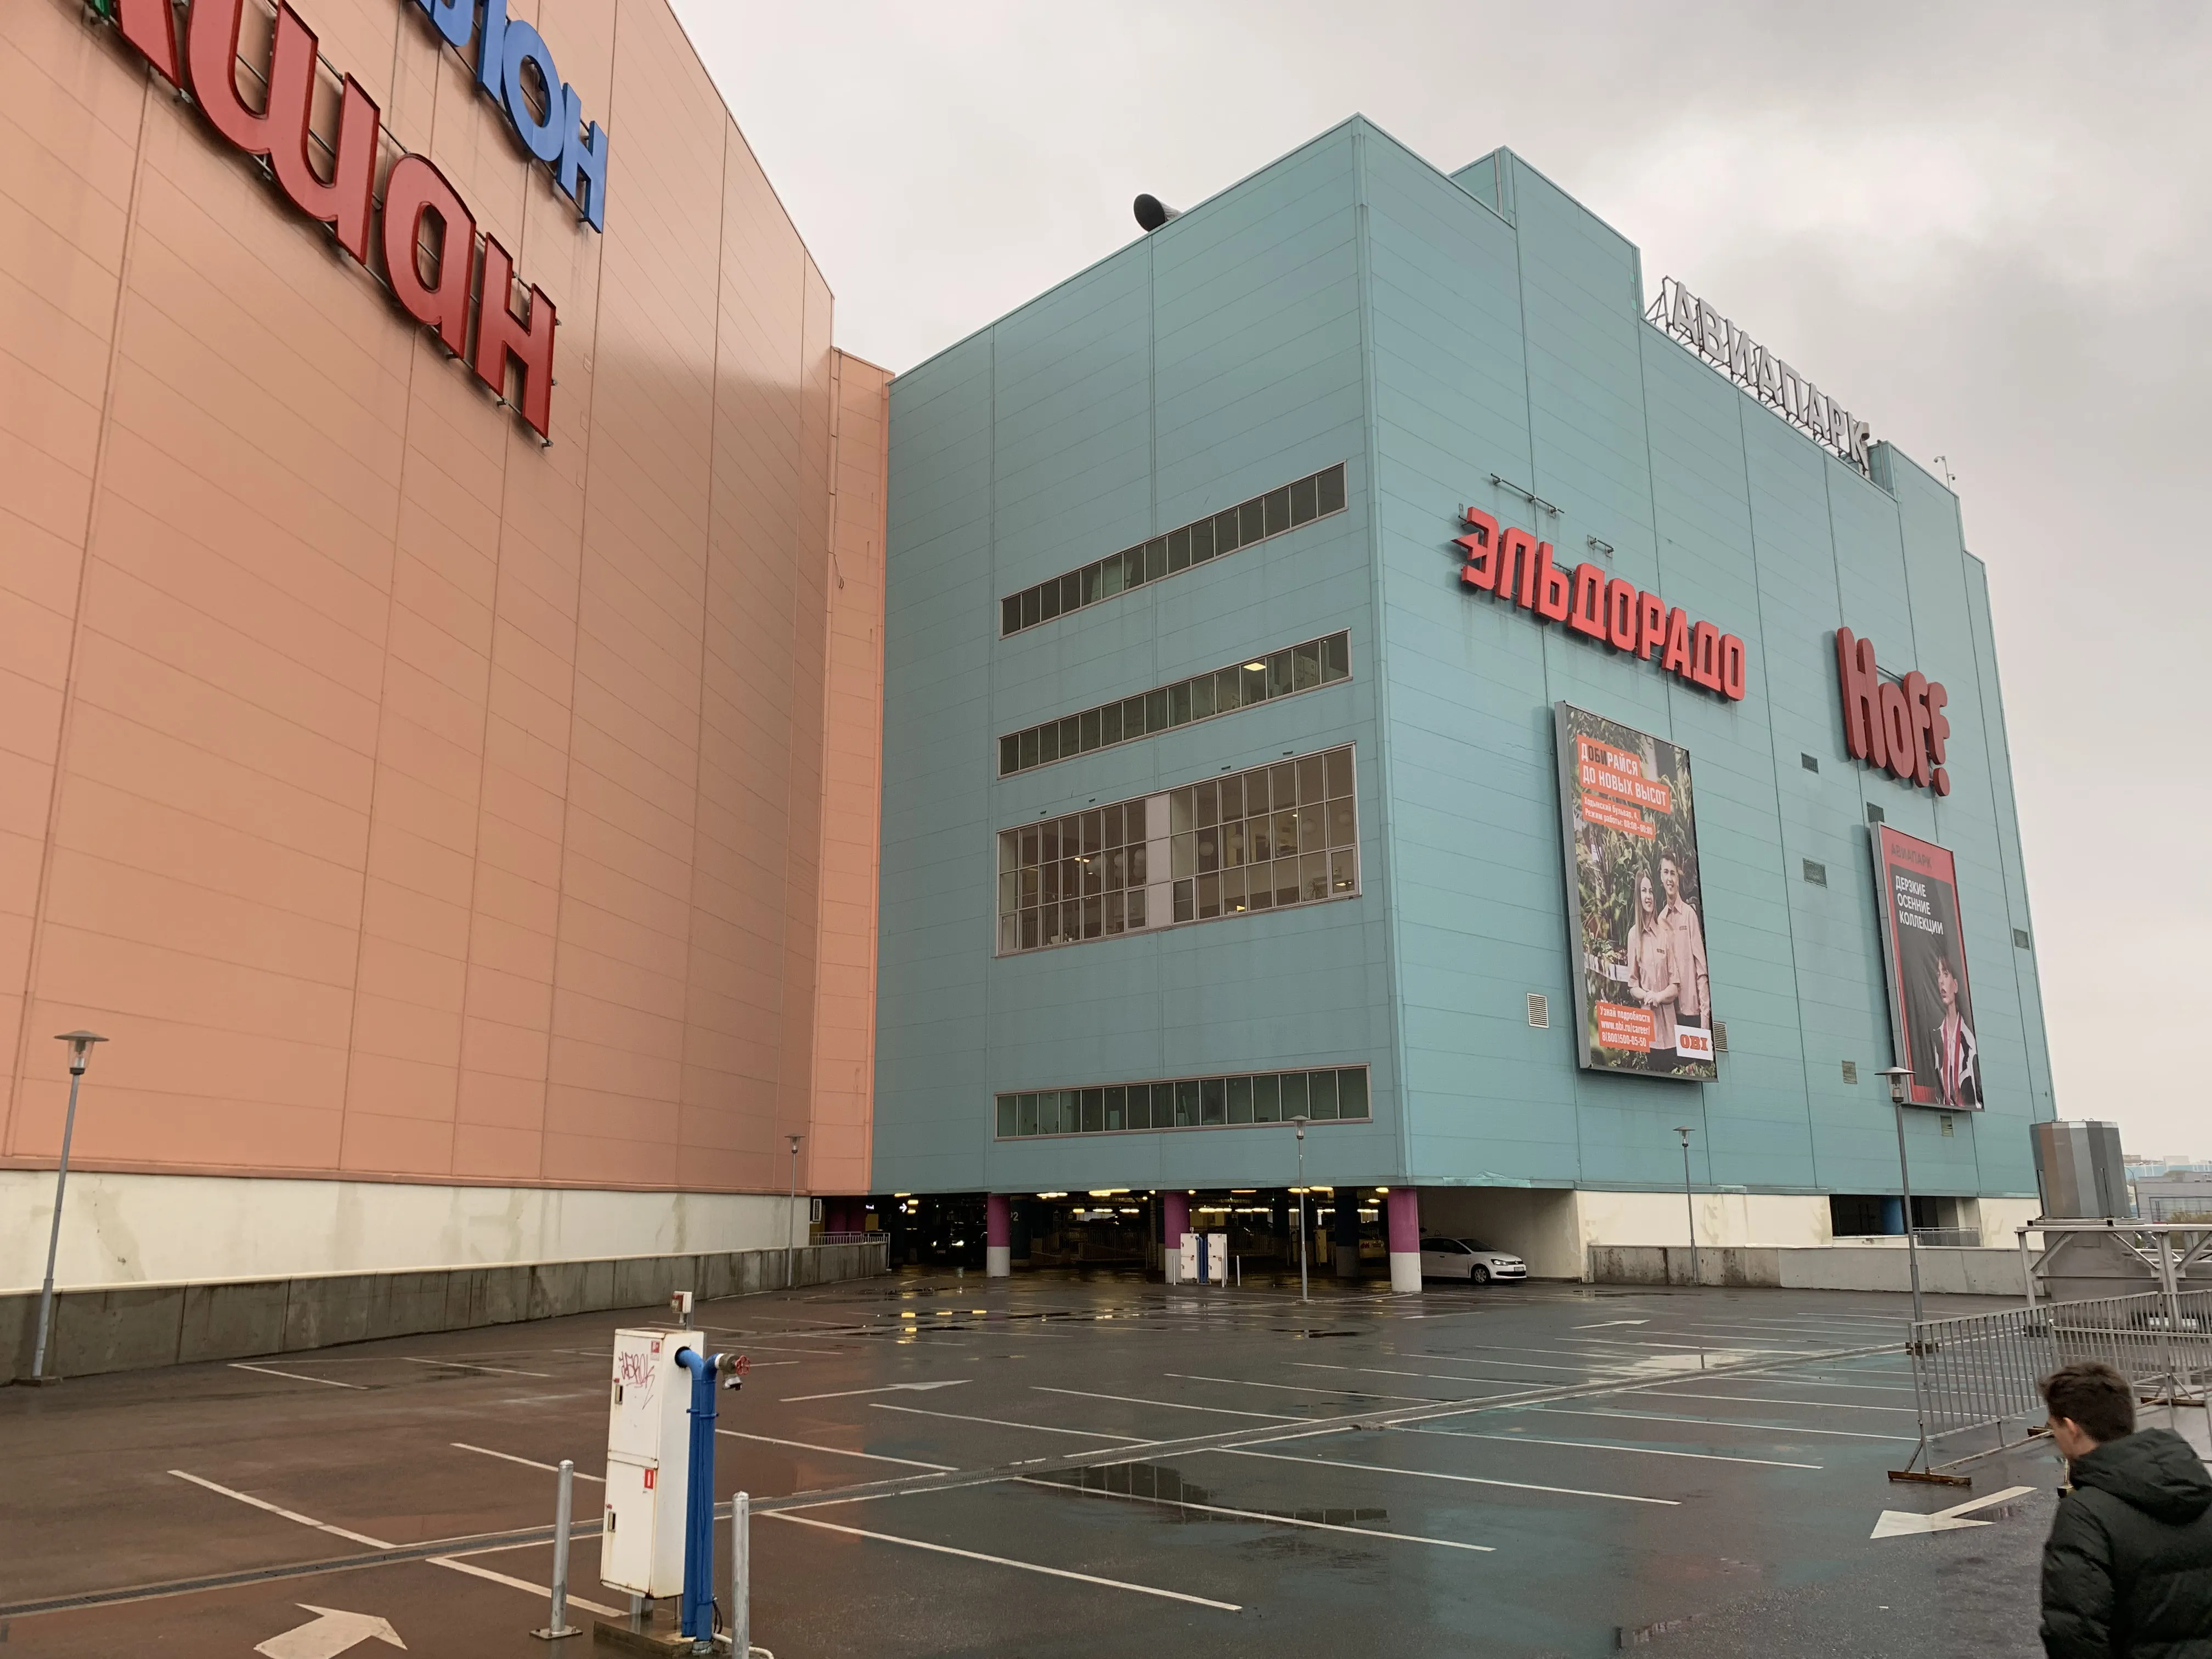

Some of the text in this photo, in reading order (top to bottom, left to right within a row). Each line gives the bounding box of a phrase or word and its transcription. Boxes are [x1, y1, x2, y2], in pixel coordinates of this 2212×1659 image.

[1672, 281, 1869, 471] АВИАПАРК
[1451, 506, 1746, 701] ЭЛЬДОРАДО
[1581, 743, 1638, 777] ДОБИРАЙСЯ
[1583, 765, 1666, 806] ДО НОВЫХ ВЫСОТ
[1584, 796, 1612, 812] Ходынский
[1585, 808, 1603, 820] Режим
[1892, 843, 1932, 870] АВИАПАРК
[1895, 875, 1927, 898] ДЕРЗКИЕ
[1897, 893, 1931, 915] ОСЕННИЕ
[1899, 910, 1944, 935] КОЛЛЕКЦИИ
[1600, 1006, 1651, 1023] Узнай подробности
[1601, 1020, 1650, 1036] www.obi.ru/career/
[1680, 1034, 1708, 1051] OBI
